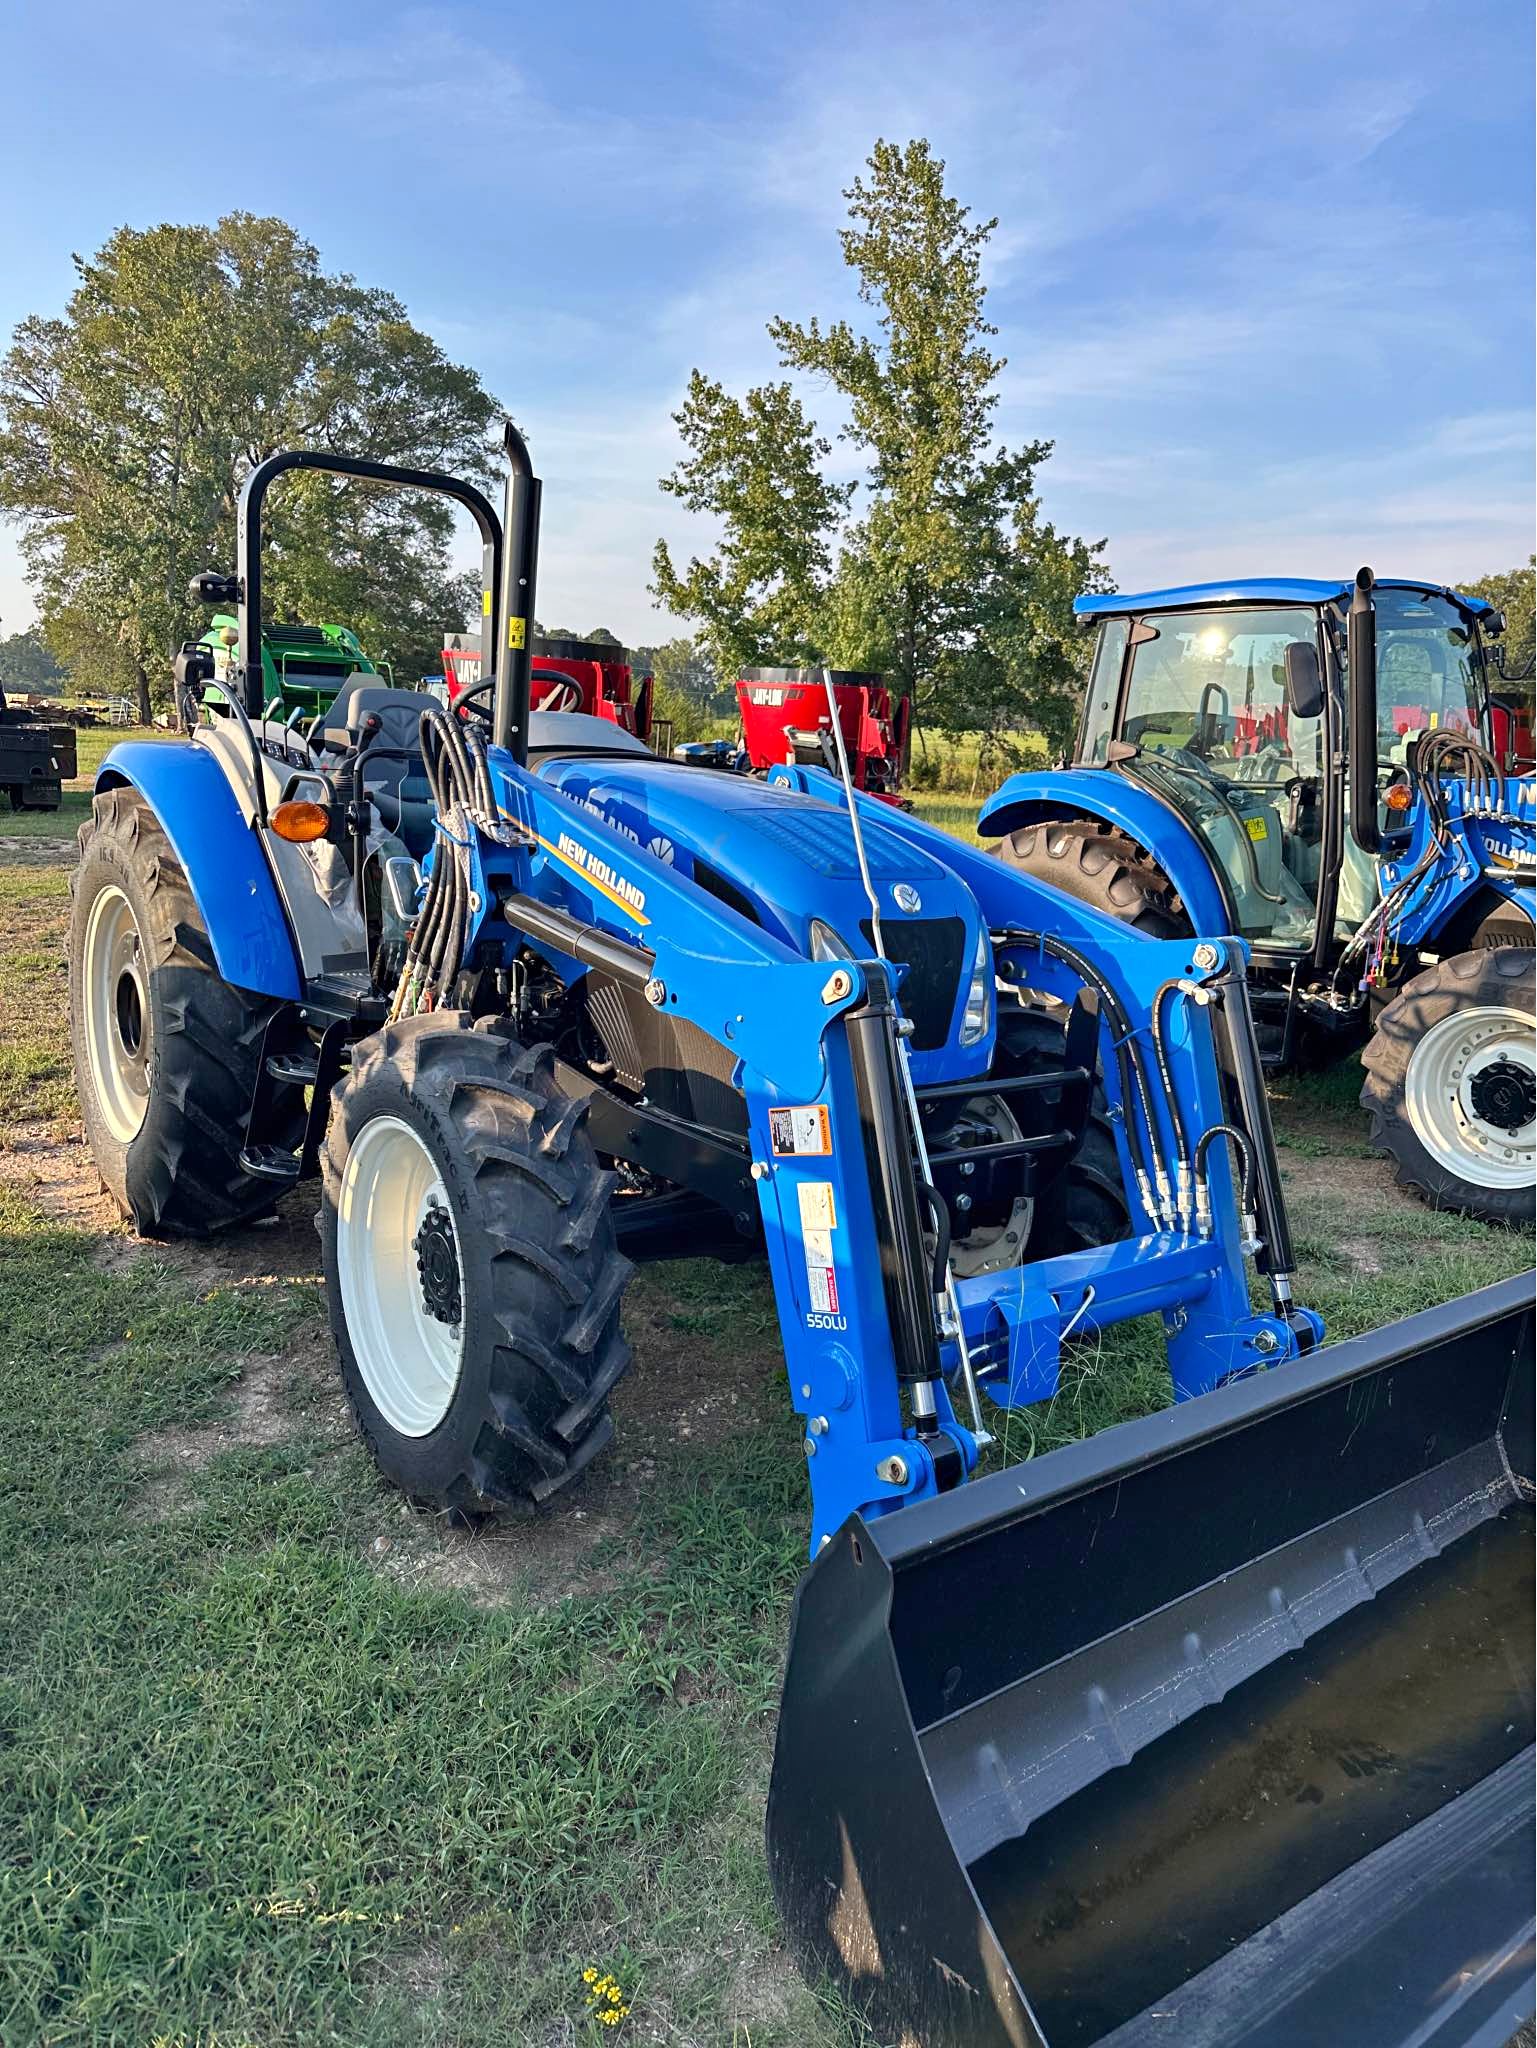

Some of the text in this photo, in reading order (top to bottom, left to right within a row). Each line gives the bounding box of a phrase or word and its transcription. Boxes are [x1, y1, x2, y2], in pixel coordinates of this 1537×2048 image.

[557, 832, 646, 912] NEW HOLLAND
[828, 1279, 837, 1311] DANGER
[806, 1313, 848, 1332] 550LU
